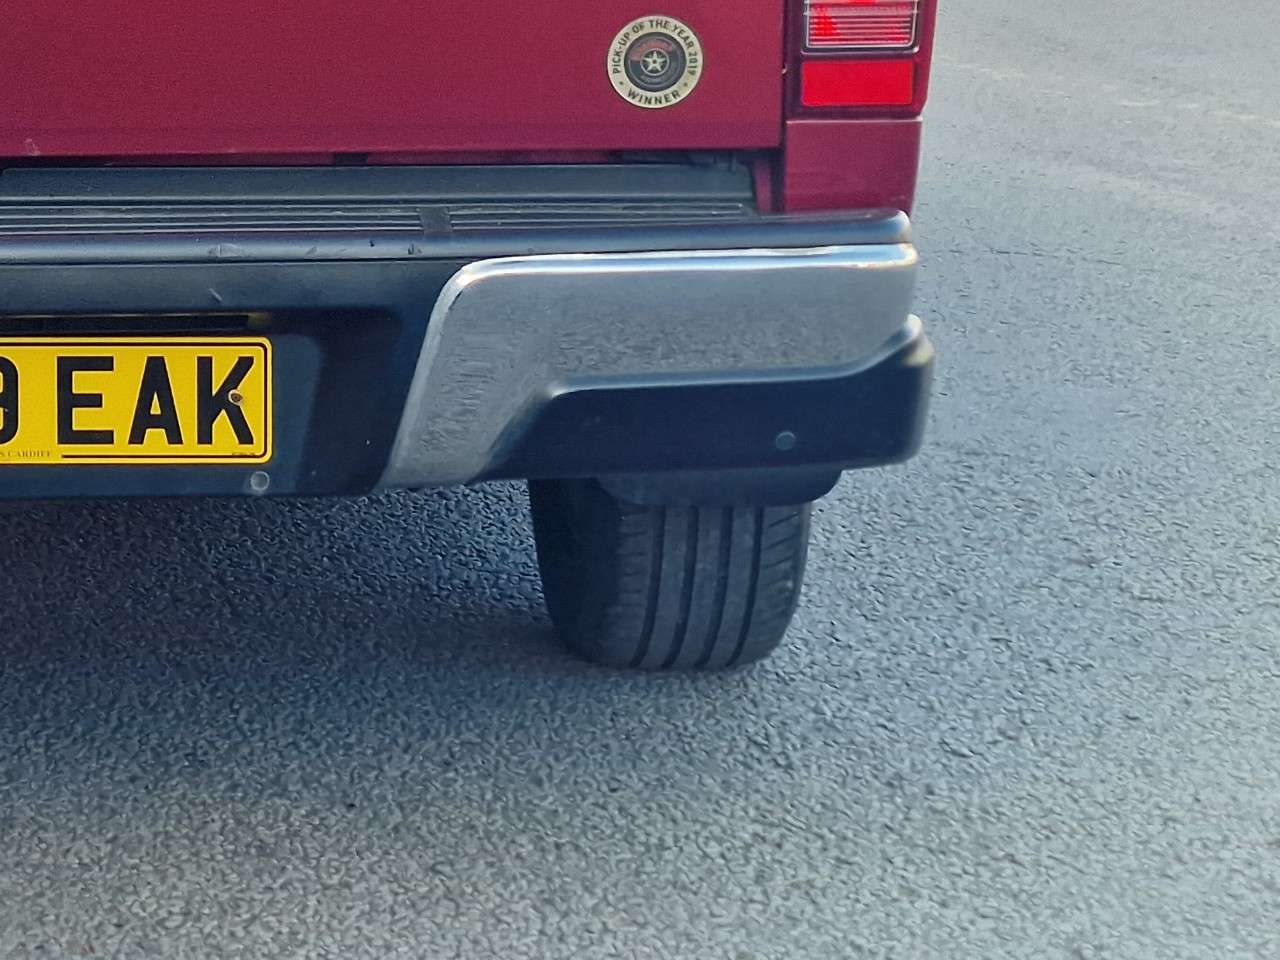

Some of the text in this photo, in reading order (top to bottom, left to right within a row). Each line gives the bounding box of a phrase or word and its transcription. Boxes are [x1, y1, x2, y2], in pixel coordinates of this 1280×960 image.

[612, 19, 698, 76] PICK-UP OF THE YEAR 2019
[627, 87, 681, 105] WINNER
[56, 354, 255, 446] EAK
